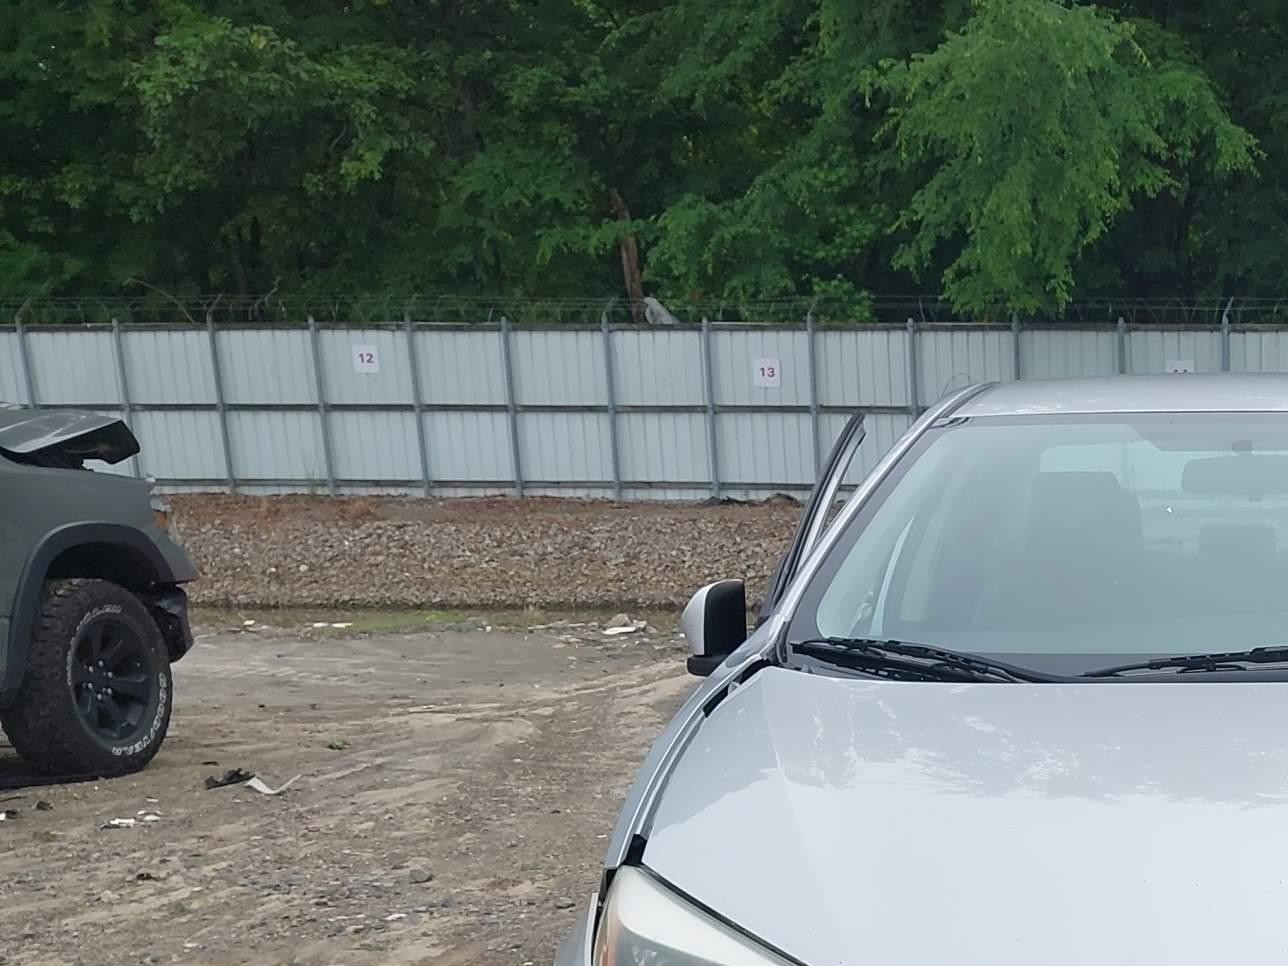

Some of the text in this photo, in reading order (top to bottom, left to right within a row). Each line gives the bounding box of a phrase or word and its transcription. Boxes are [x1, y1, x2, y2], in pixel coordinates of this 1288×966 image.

[358, 352, 375, 364] 12
[760, 367, 776, 378] 13
[111, 672, 167, 756] GOODYEAR
